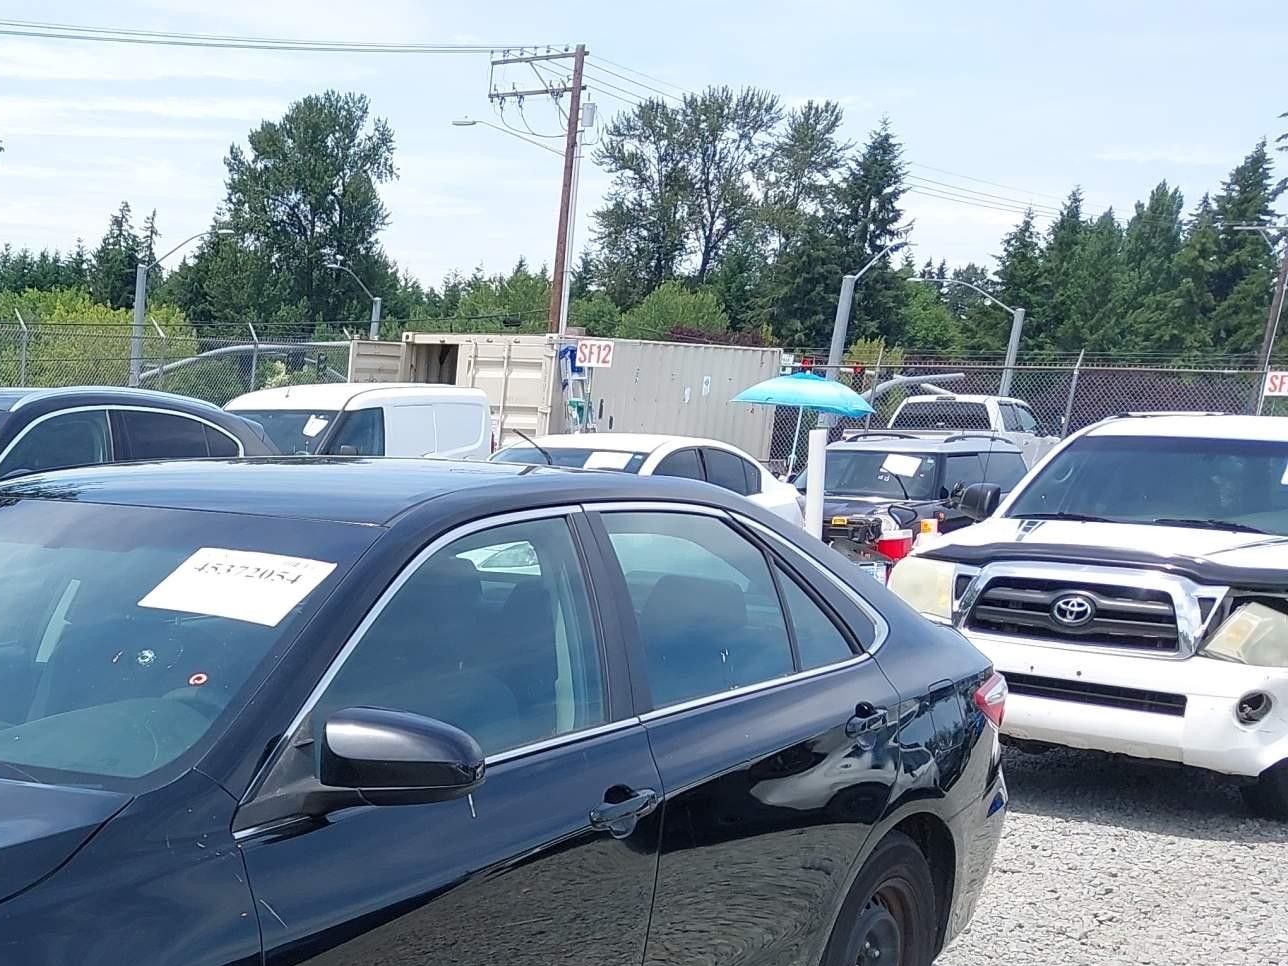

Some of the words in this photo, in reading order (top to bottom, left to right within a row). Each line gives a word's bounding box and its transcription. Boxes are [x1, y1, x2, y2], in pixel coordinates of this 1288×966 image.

[578, 343, 612, 364] SF12
[1268, 374, 1288, 393] SF
[193, 561, 304, 585] 45372054
